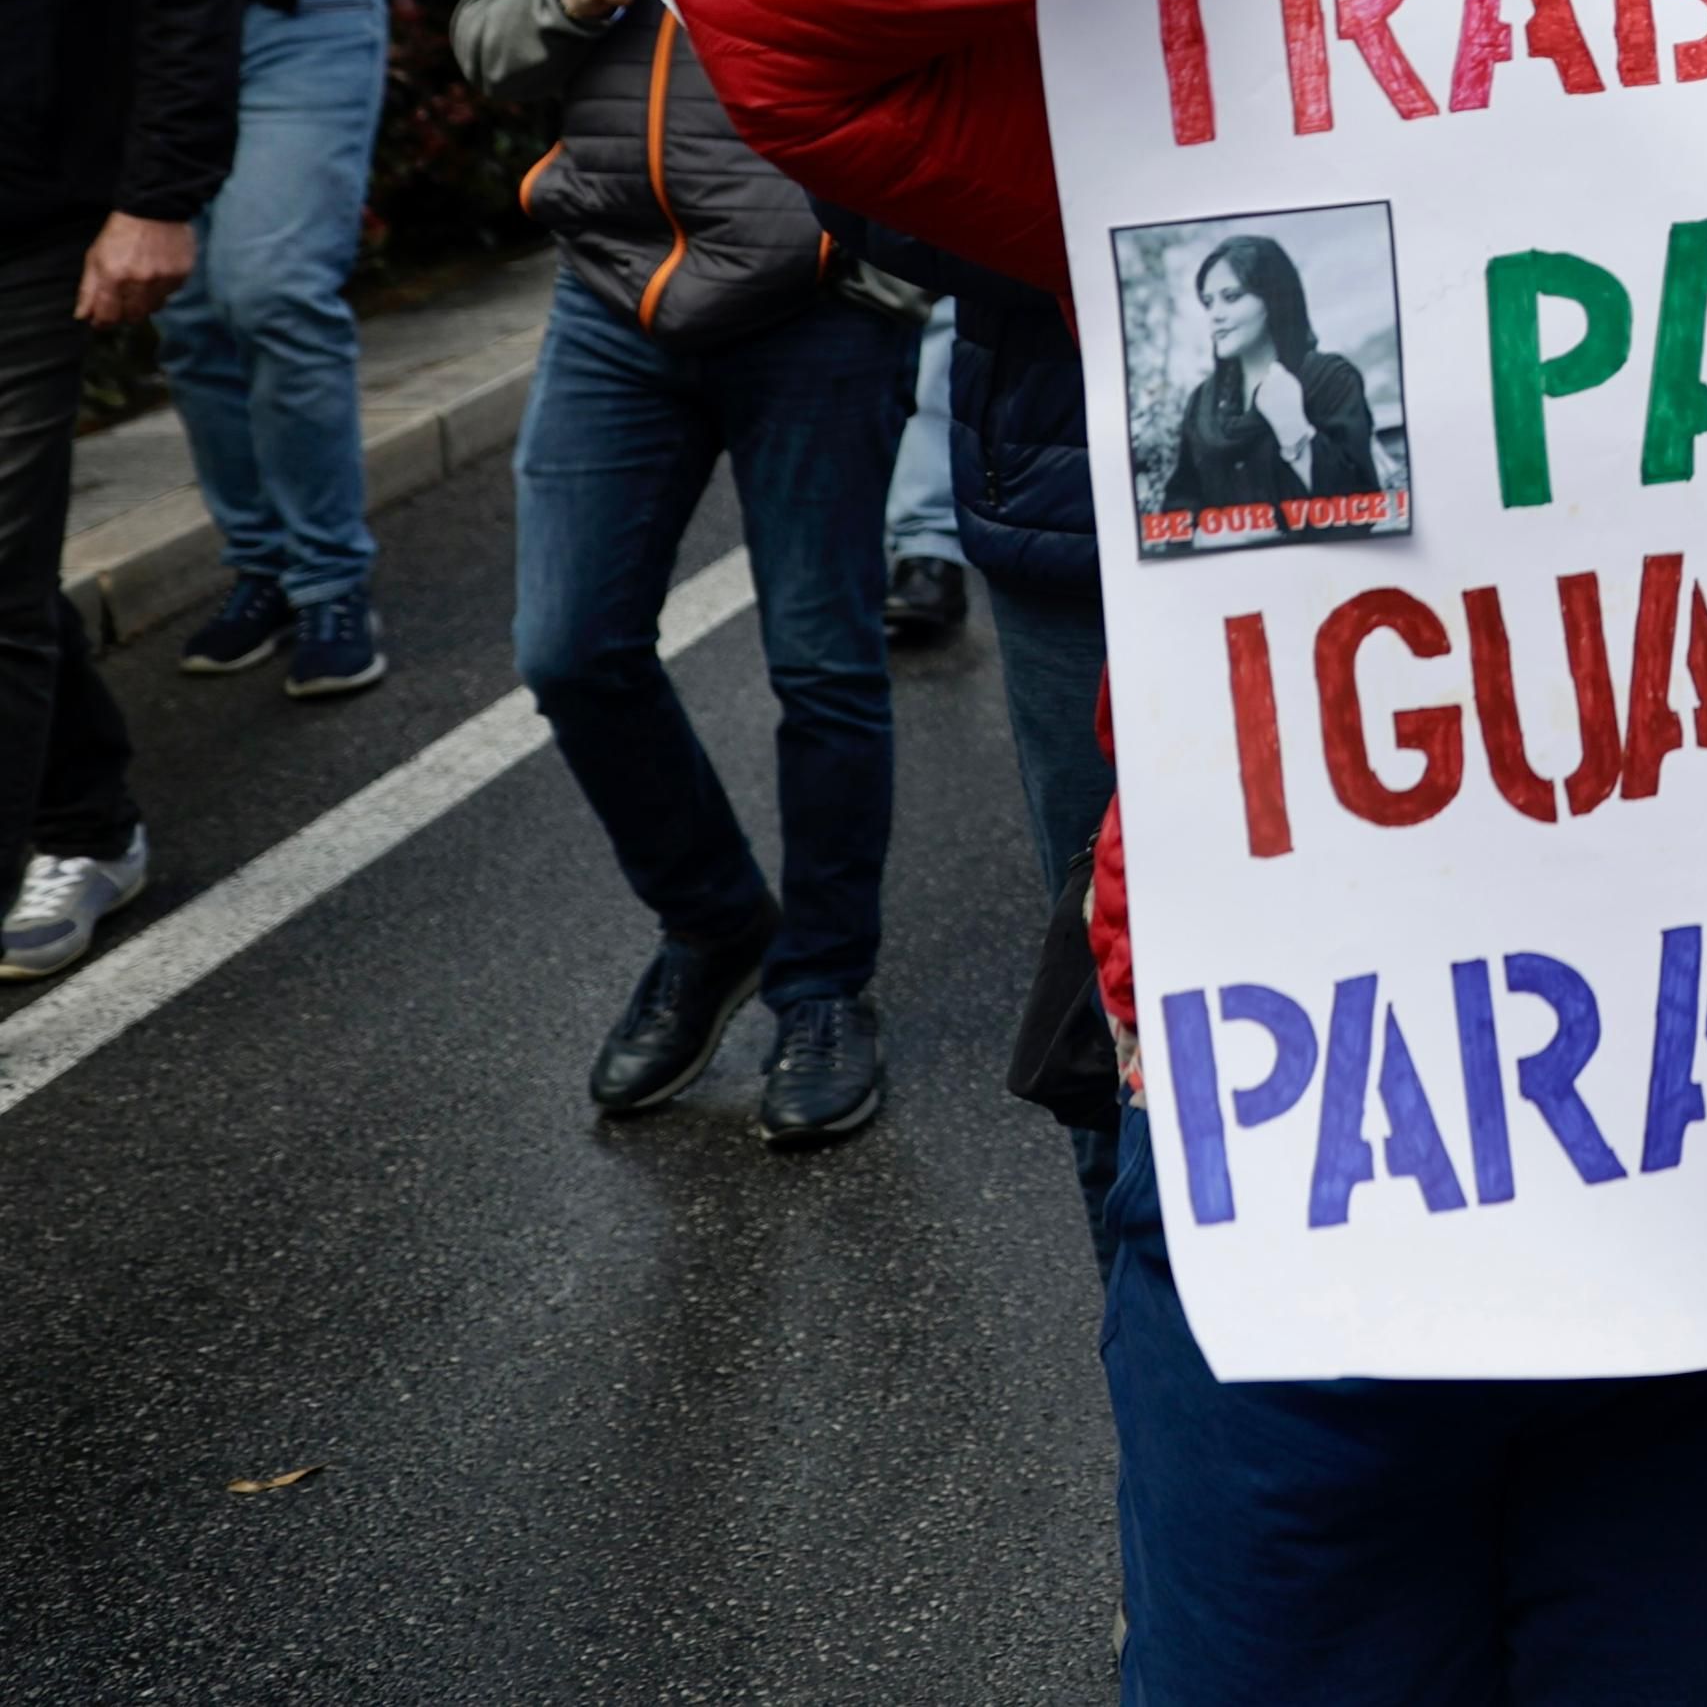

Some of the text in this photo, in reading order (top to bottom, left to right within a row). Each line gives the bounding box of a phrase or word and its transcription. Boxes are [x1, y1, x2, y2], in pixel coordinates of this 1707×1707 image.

[1142, 508, 1193, 542] BE
[1200, 500, 1276, 536] OUR
[1281, 491, 1390, 530] VOICE
